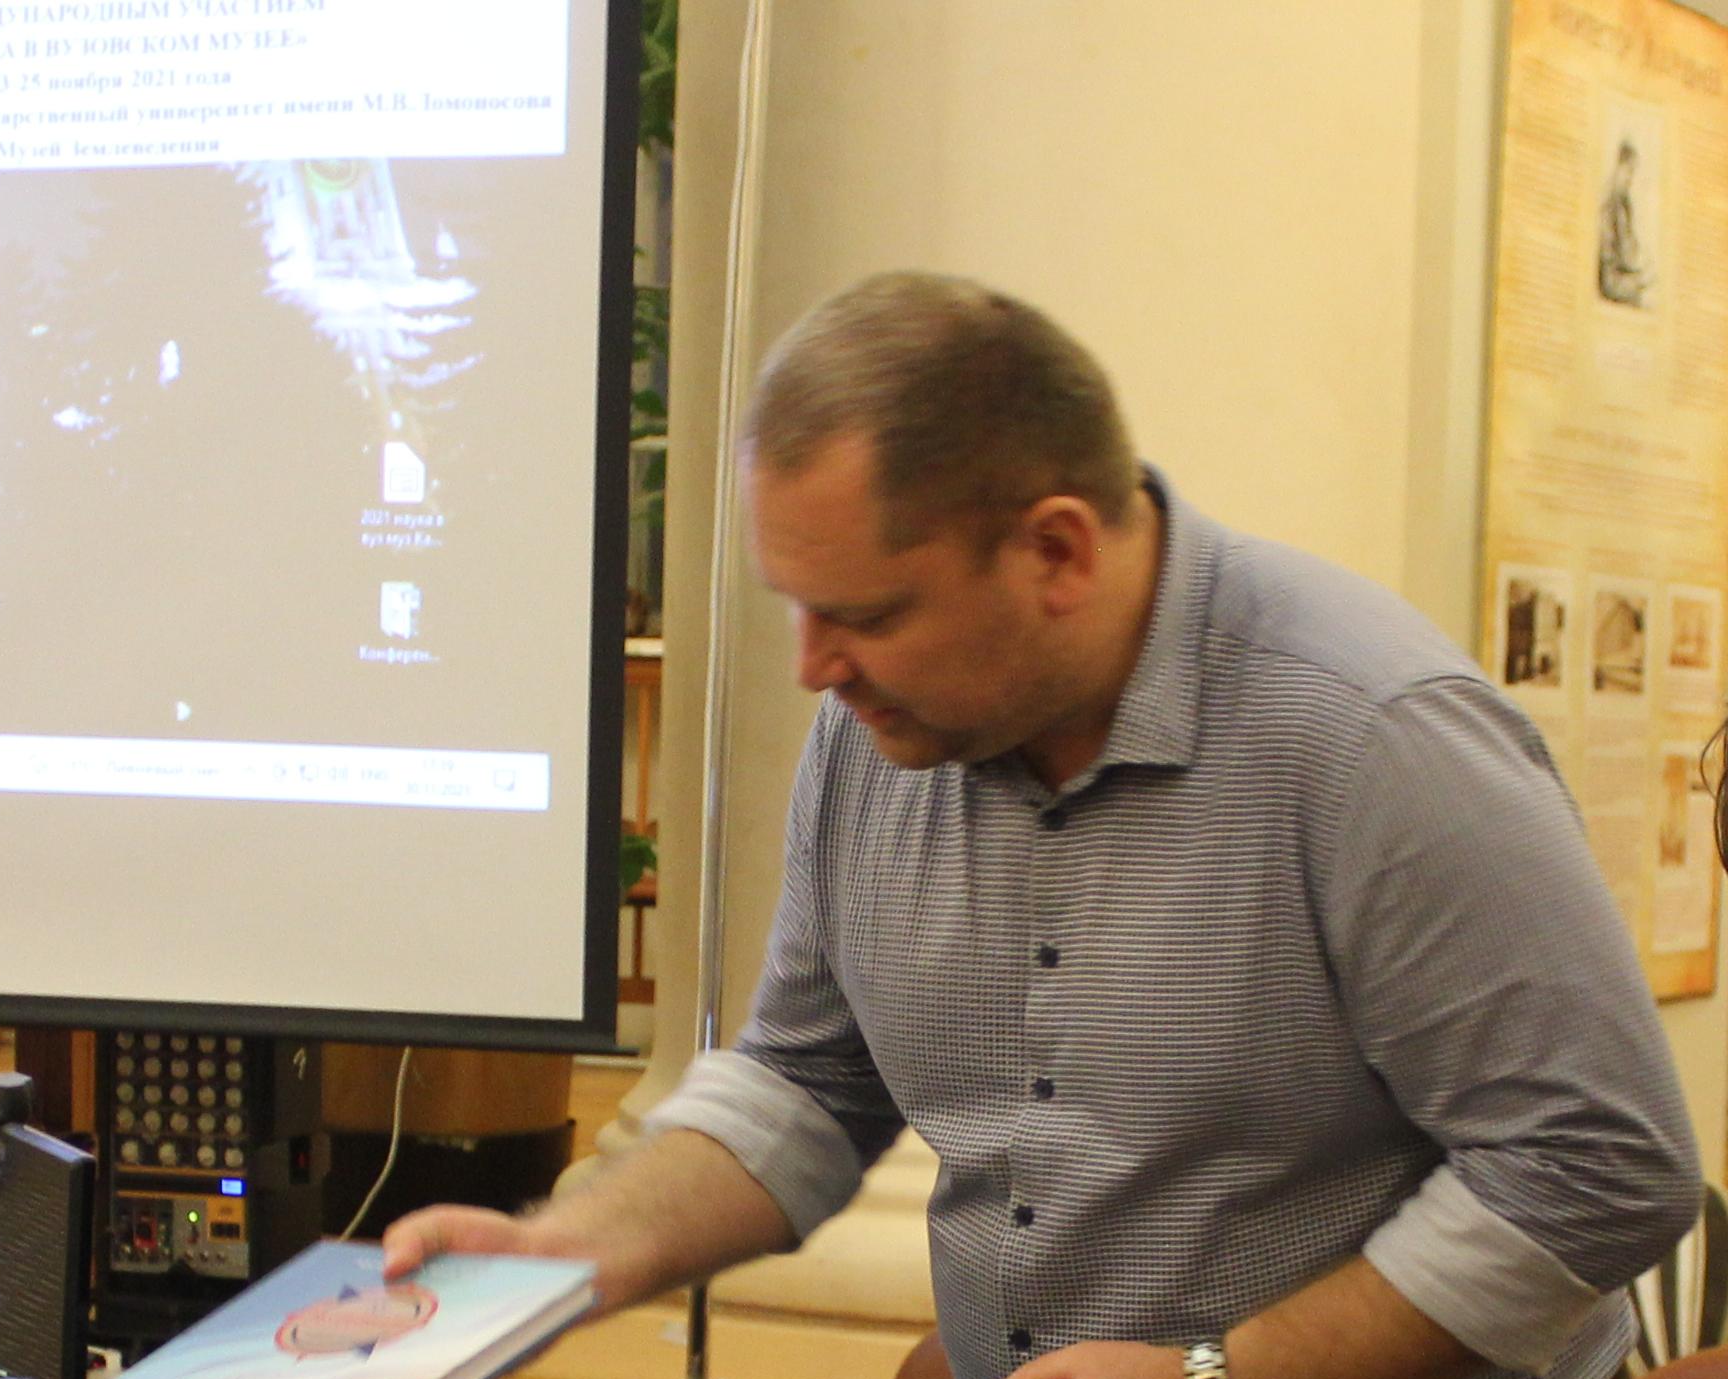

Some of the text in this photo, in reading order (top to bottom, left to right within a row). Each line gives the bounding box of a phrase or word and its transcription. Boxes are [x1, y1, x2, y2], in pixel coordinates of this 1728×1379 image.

[46, 32, 201, 59] ВУЗОВСКОМ
[48, 71, 124, 96] ноября
[131, 68, 176, 88] 2021
[184, 71, 233, 89] года
[136, 100, 275, 128] университет
[283, 98, 355, 115] имени
[422, 93, 553, 114] Ломоносова
